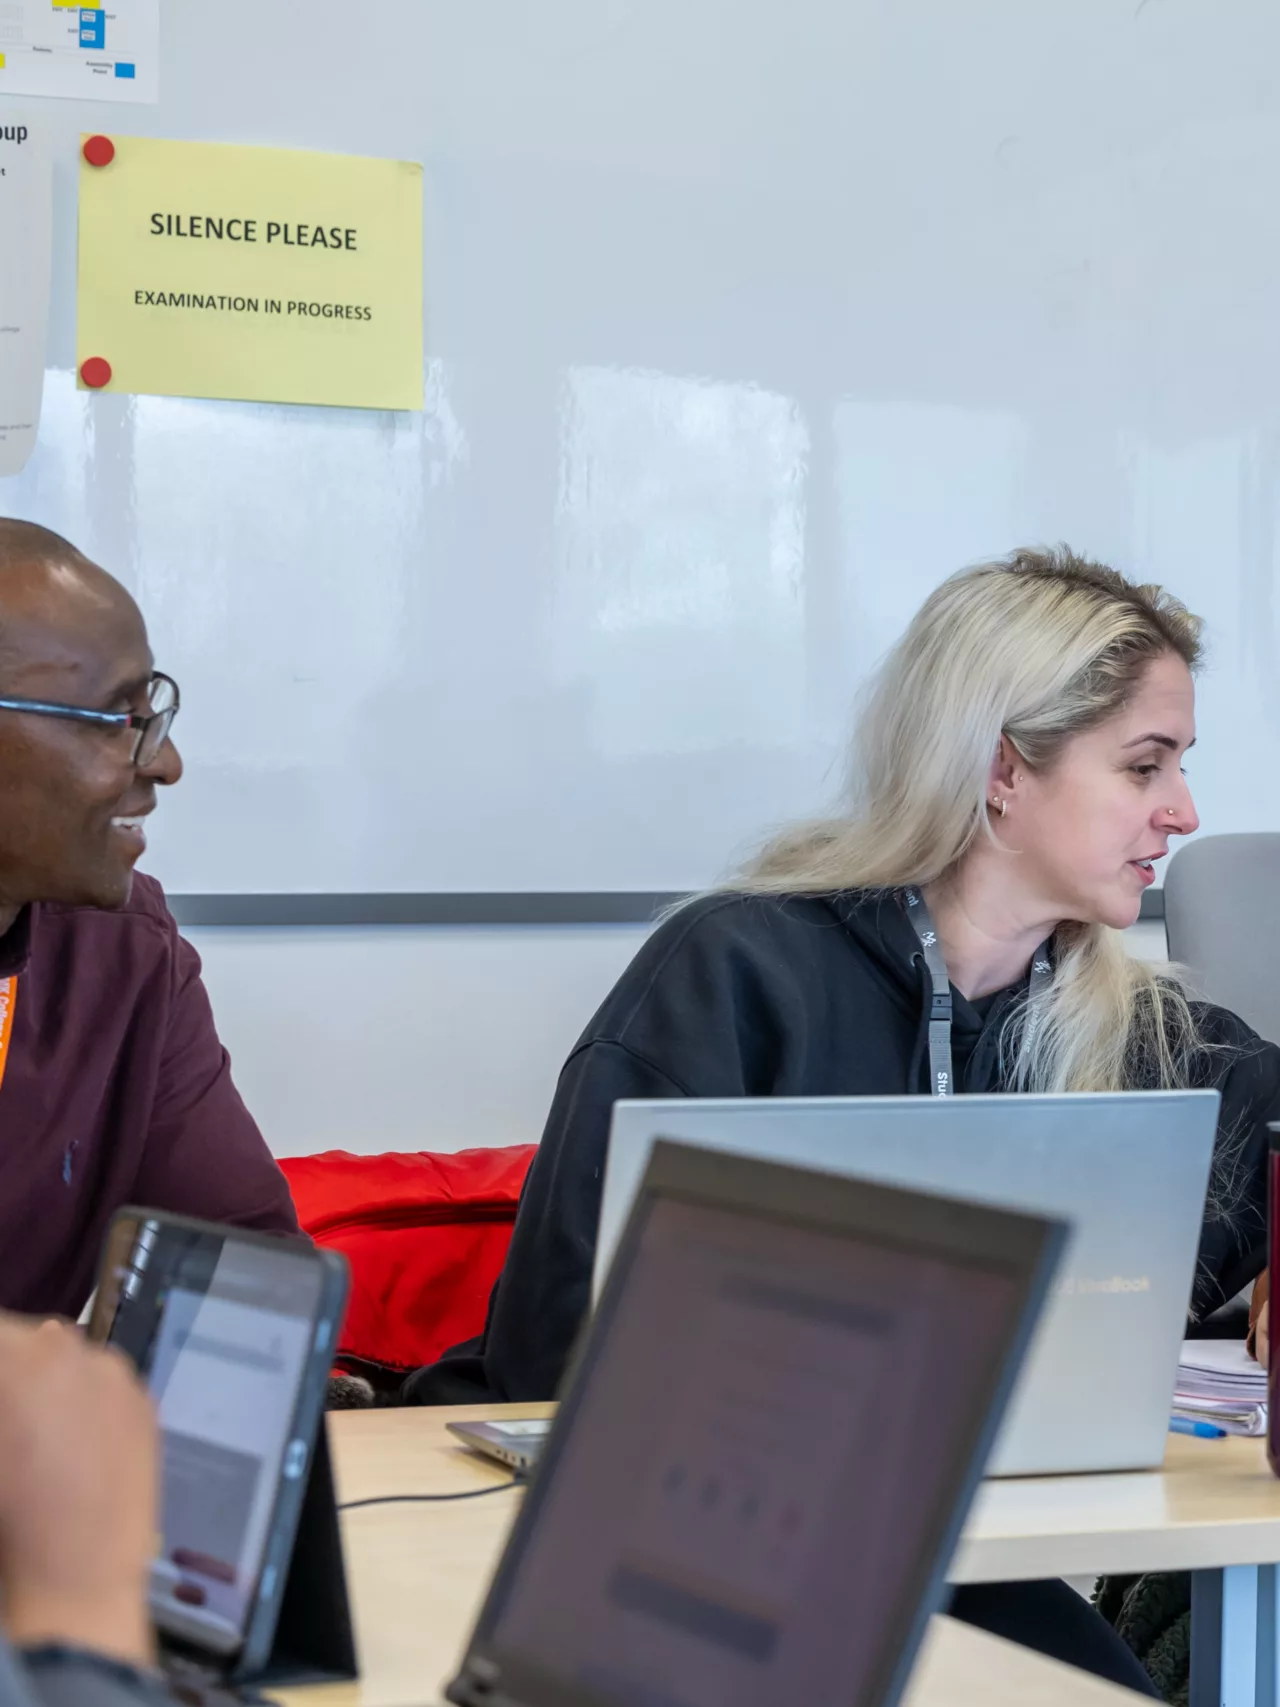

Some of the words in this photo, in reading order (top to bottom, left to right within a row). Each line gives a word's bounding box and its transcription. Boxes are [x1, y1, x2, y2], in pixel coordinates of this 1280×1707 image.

[150, 213, 257, 242] SILENCE
[266, 222, 357, 251] PLEASE
[134, 290, 258, 313] EXAMINATION
[265, 299, 282, 314] IN
[287, 301, 372, 321] PROGRESS
